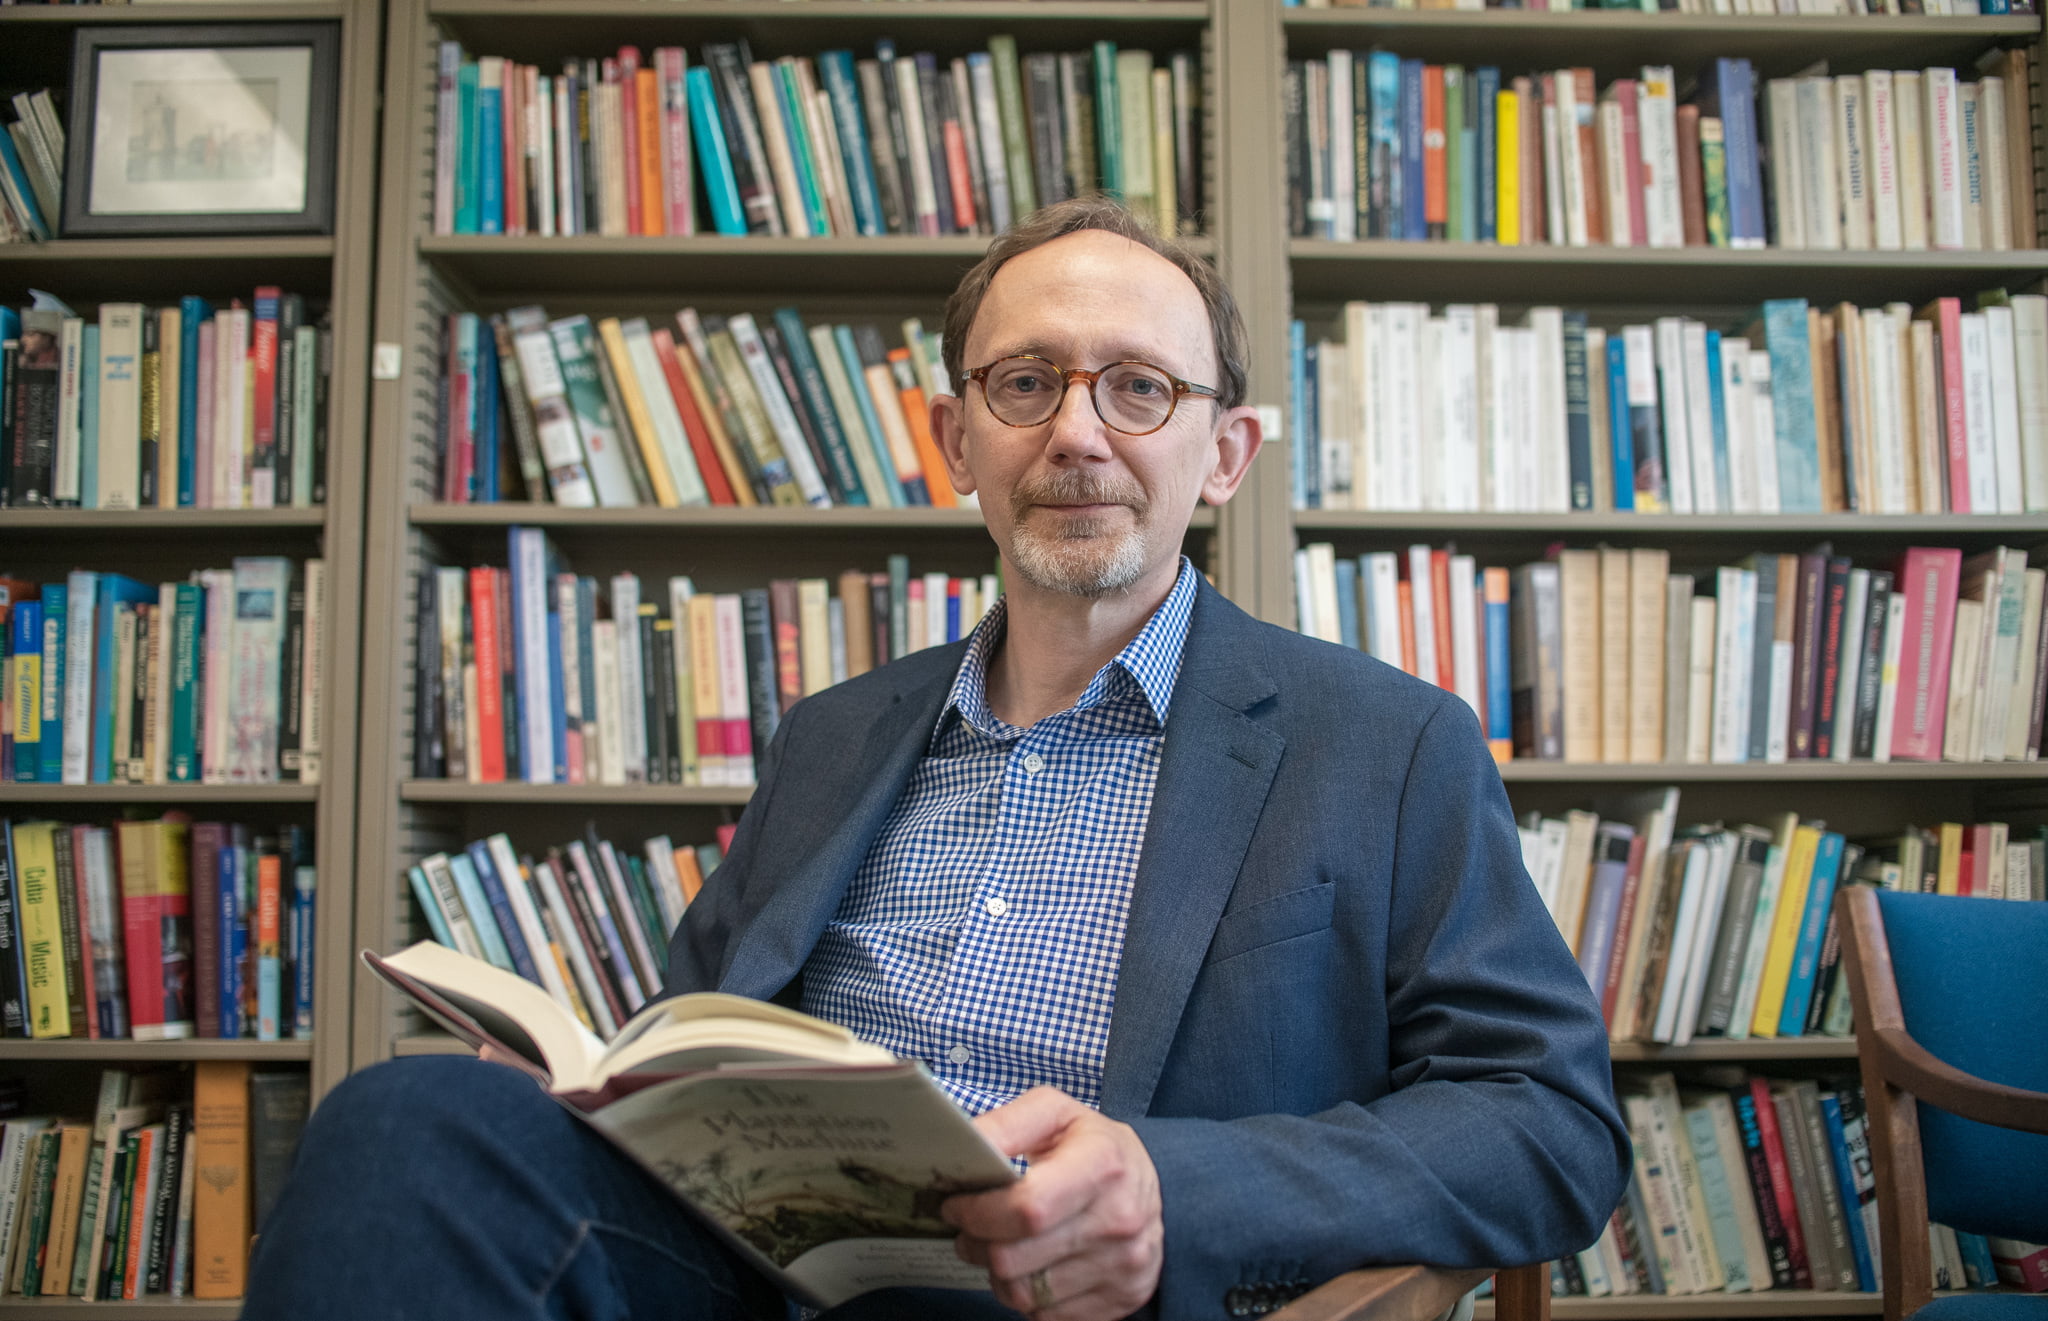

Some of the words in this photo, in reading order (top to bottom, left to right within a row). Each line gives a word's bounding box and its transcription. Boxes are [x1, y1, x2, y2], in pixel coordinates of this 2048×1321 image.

[43, 618, 58, 722] CARIBBEAN
[24, 865, 48, 905] Cuba
[0, 899, 14, 949] Banjo
[30, 941, 52, 988] Music
[734, 1084, 810, 1107] The
[702, 1110, 892, 1137] Plantation
[740, 1128, 897, 1153] Machine
